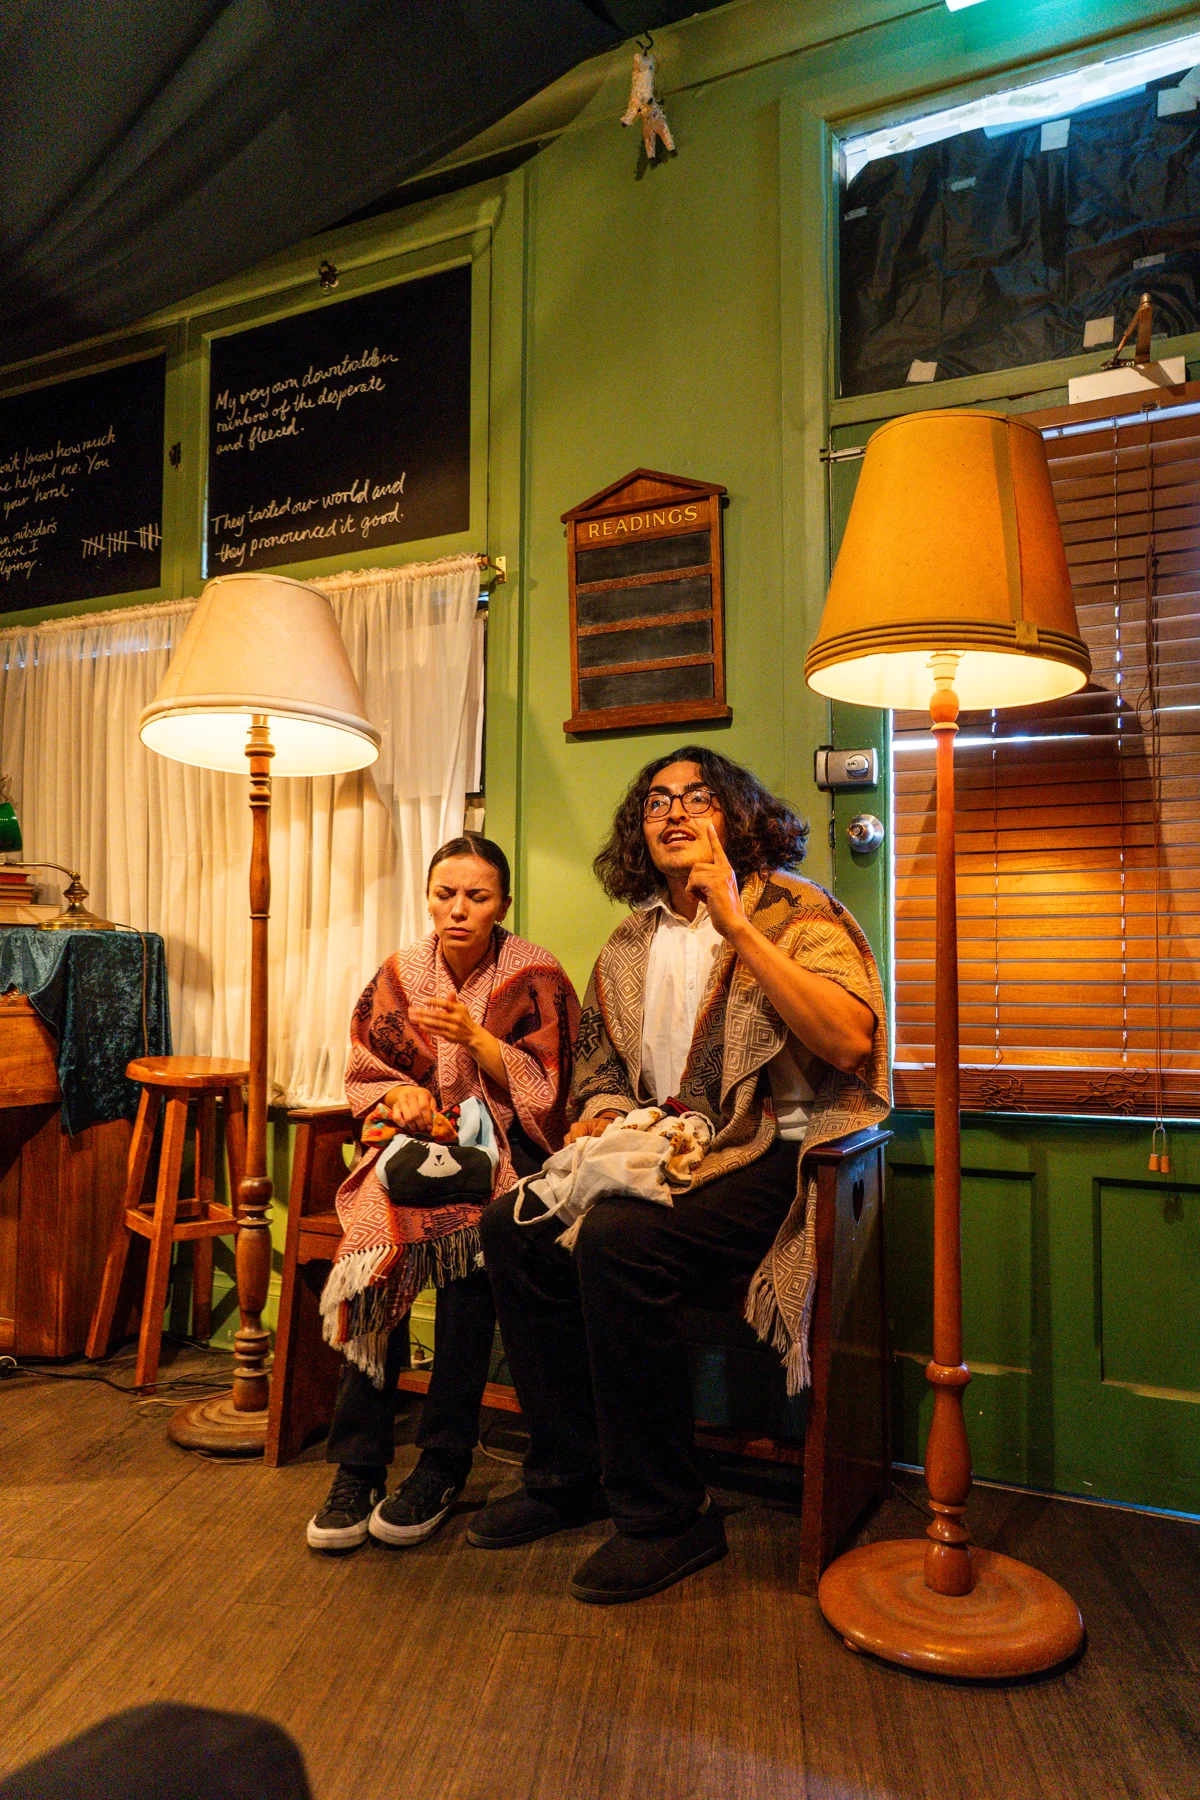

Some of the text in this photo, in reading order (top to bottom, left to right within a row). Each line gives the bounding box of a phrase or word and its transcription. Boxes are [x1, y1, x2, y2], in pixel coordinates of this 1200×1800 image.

[215, 347, 399, 420] My very own downtrodden
[216, 375, 386, 433] rainbow of the desperate
[0, 425, 115, 473] on't know how much
[216, 417, 305, 455] and fleeced.
[15, 463, 56, 490] helped
[86, 452, 110, 475] You
[4, 496, 29, 520] your
[211, 472, 406, 537] They tasted our world and
[588, 505, 698, 539] READINGS
[215, 502, 404, 568] they pronounced it good.
